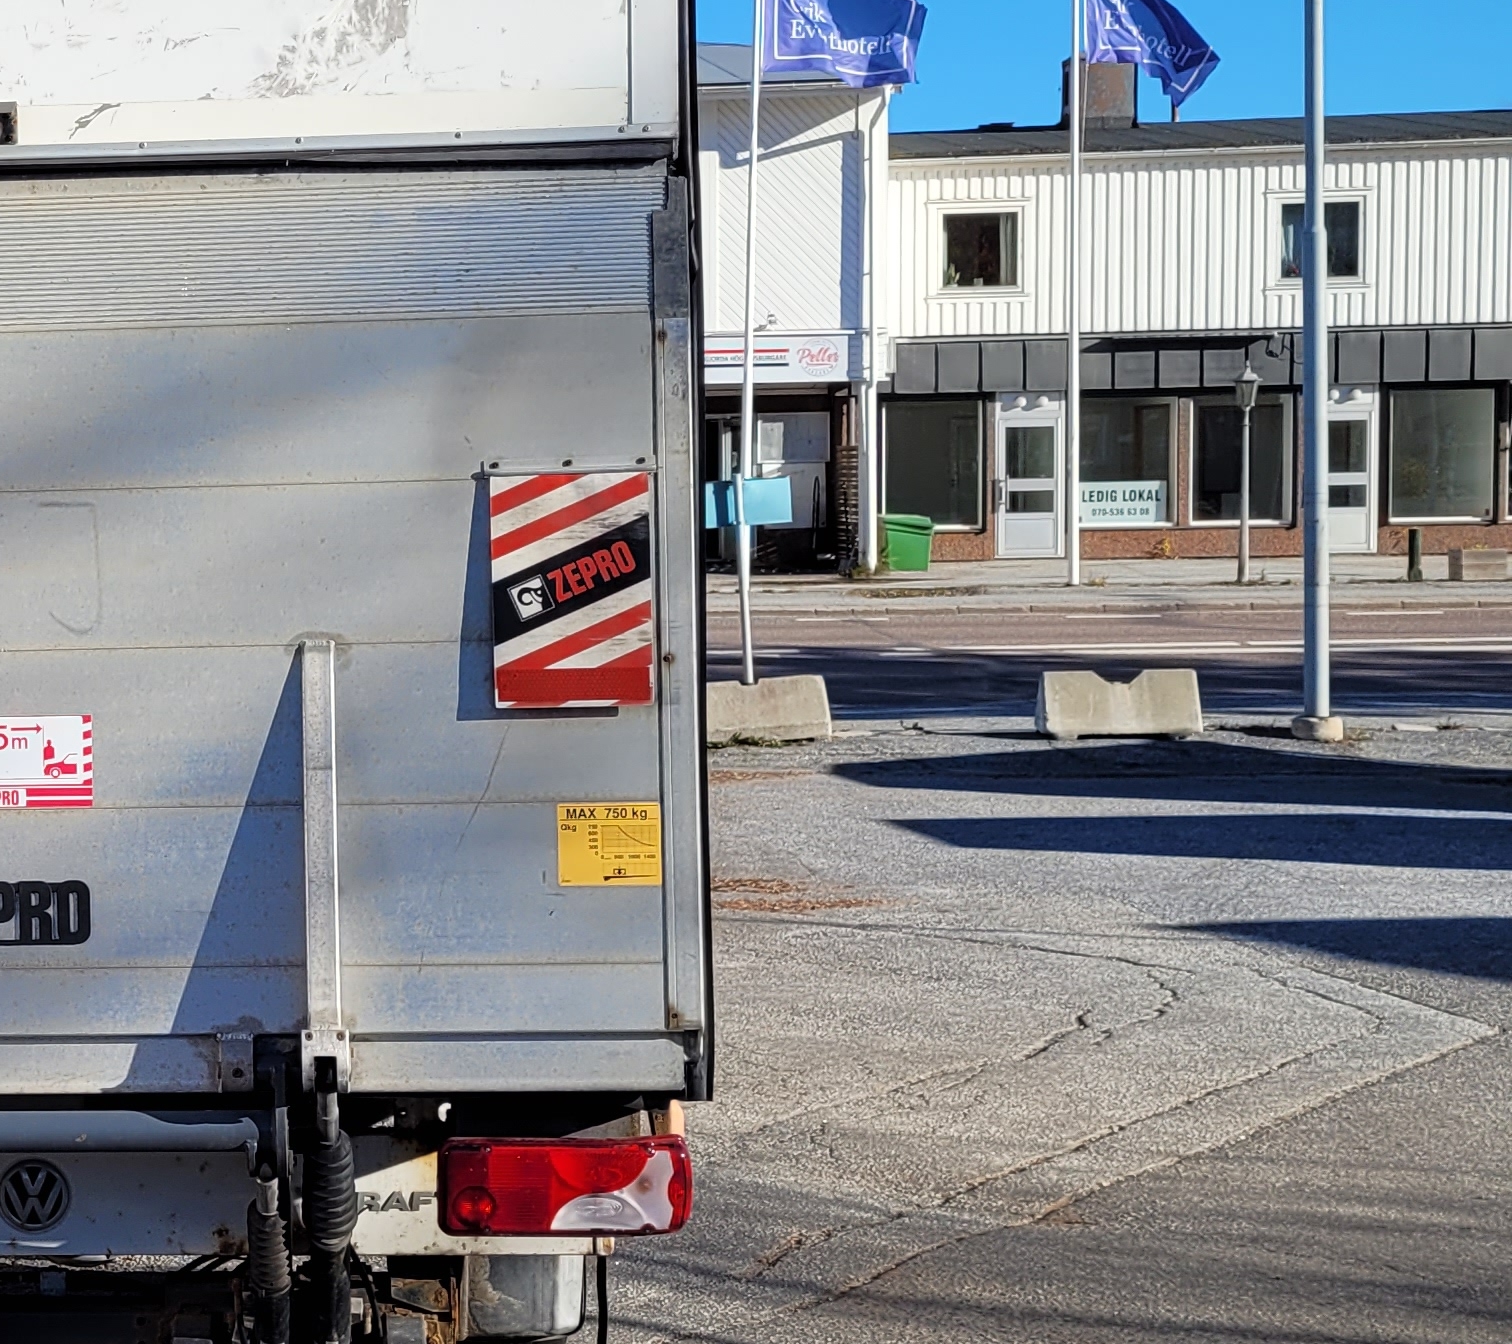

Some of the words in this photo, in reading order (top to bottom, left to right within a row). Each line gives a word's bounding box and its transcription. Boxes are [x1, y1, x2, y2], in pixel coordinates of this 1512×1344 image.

[1082, 490, 1118, 503] LEDIG
[1122, 489, 1162, 502] LOKAL
[546, 540, 637, 603] ZEPRO
[11, 735, 29, 750] m
[566, 808, 597, 819] MAX
[604, 808, 628, 819] 750
[632, 807, 648, 821] kg
[356, 1190, 438, 1212] RAF
